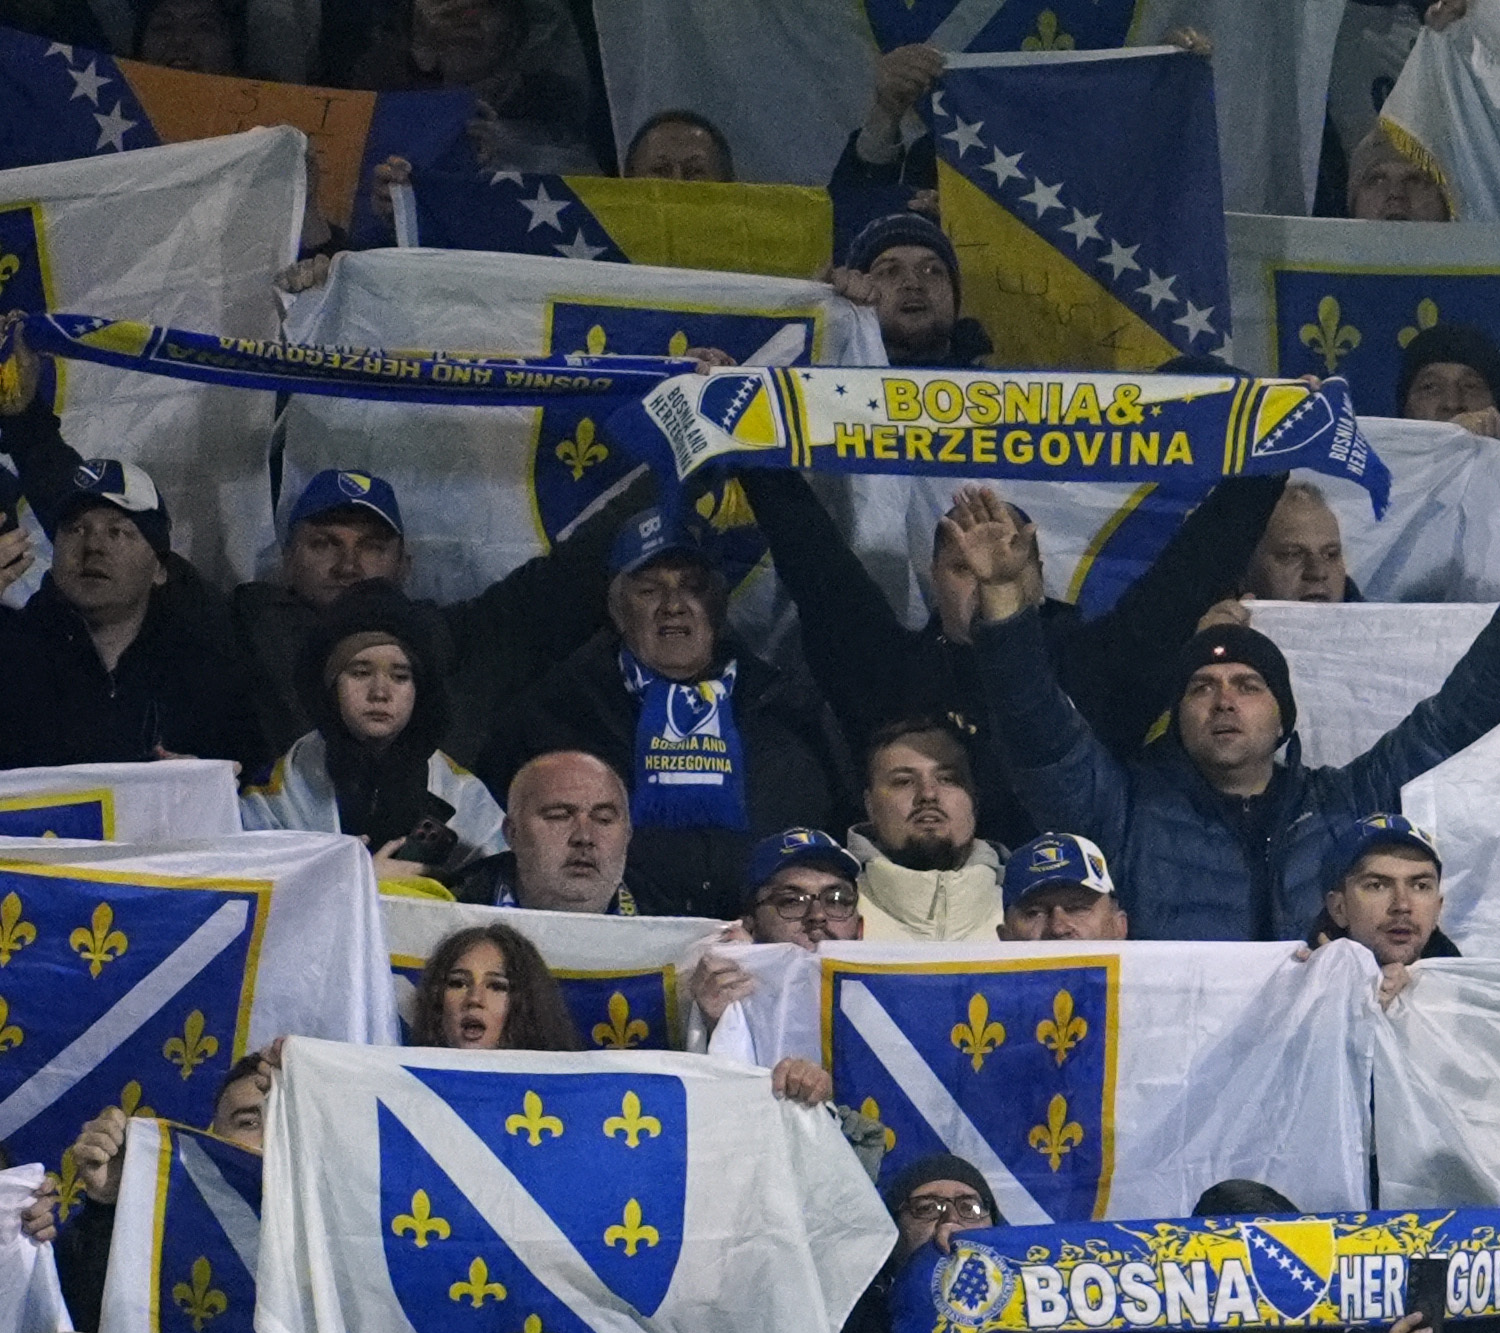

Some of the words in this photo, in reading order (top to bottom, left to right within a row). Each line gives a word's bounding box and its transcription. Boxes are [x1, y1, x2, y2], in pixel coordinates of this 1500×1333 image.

[834, 427, 1194, 467] HERZEGOVINA
[703, 735, 727, 753] AND
[645, 755, 732, 774] HERZEGOVINA
[1024, 1260, 1254, 1330] BOSNA
